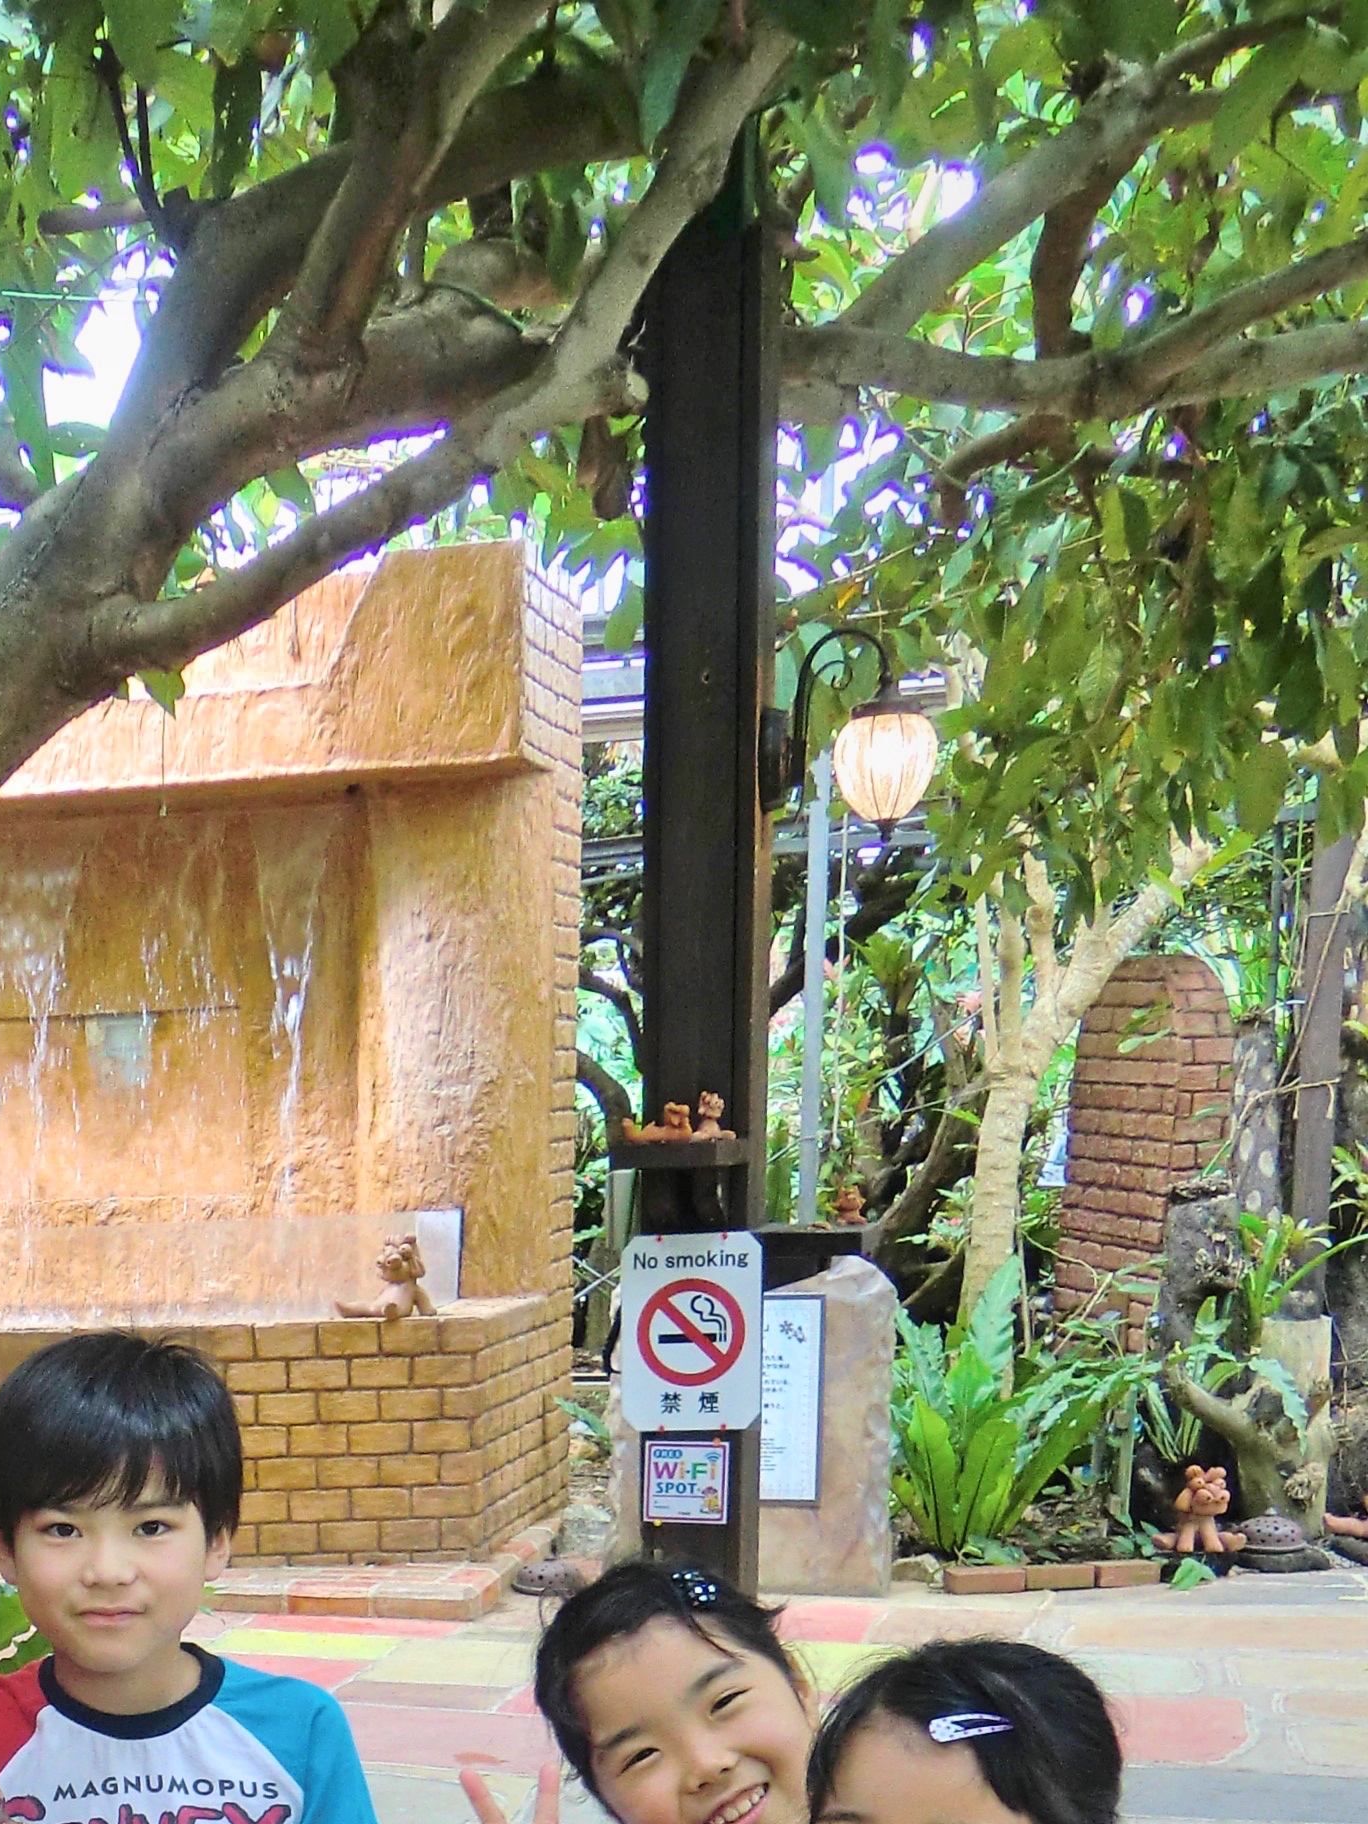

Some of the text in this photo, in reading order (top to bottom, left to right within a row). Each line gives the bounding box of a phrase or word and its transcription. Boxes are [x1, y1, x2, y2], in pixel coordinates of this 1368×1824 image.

[633, 1249, 749, 1270] No smoking
[660, 1391, 720, 1414] 禁煙
[653, 1460, 716, 1480] Wi-Fi
[656, 1482, 698, 1494] SPOT
[53, 1775, 279, 1801] MAGNUMOPUS
